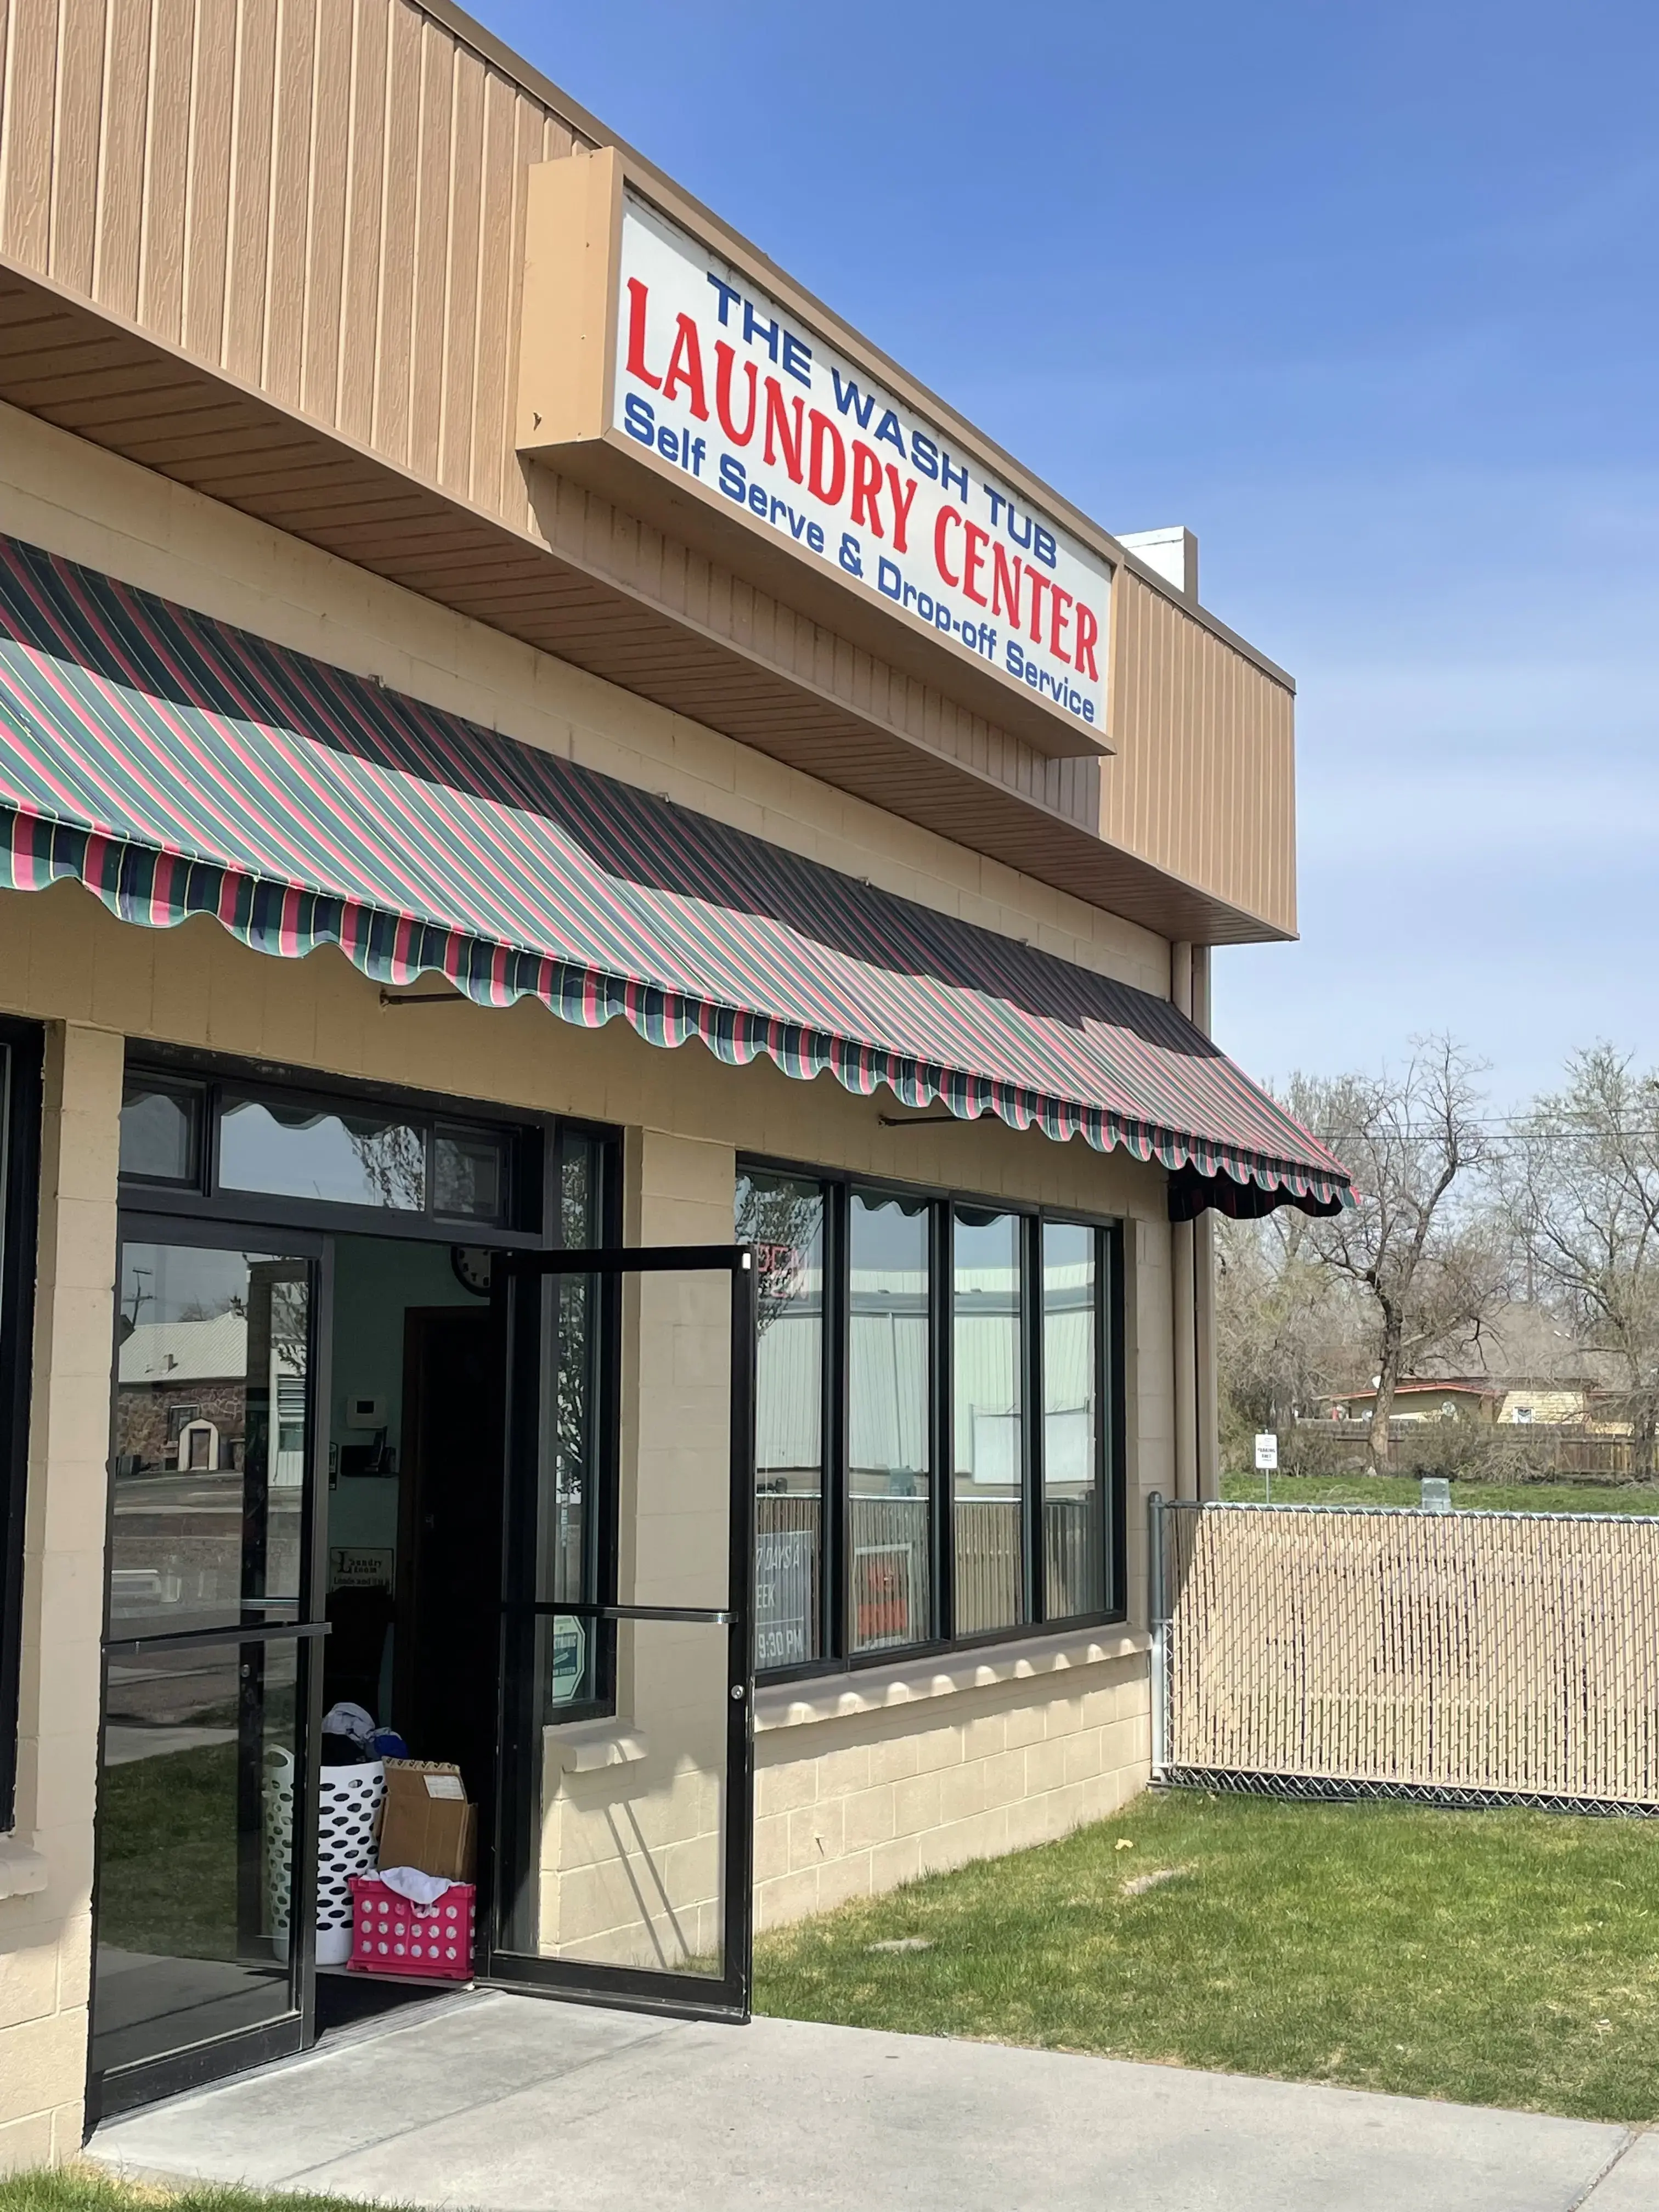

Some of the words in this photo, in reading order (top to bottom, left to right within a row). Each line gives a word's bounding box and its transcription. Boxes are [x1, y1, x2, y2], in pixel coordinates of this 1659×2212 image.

[624, 392, 706, 476] Self
[719, 453, 825, 553] Serve
[839, 532, 864, 579] &
[878, 555, 997, 659] Drop-off
[1006, 640, 1094, 723] Service
[626, 277, 918, 554] LAUNDRY
[934, 505, 1098, 682] CENTER
[707, 272, 812, 389] THE
[831, 366, 969, 503] WASH
[984, 483, 1057, 568] TUB
[758, 1630, 784, 1659] 9:30
[786, 1628, 804, 1654] PM
[765, 1544, 792, 1571] DAYS
